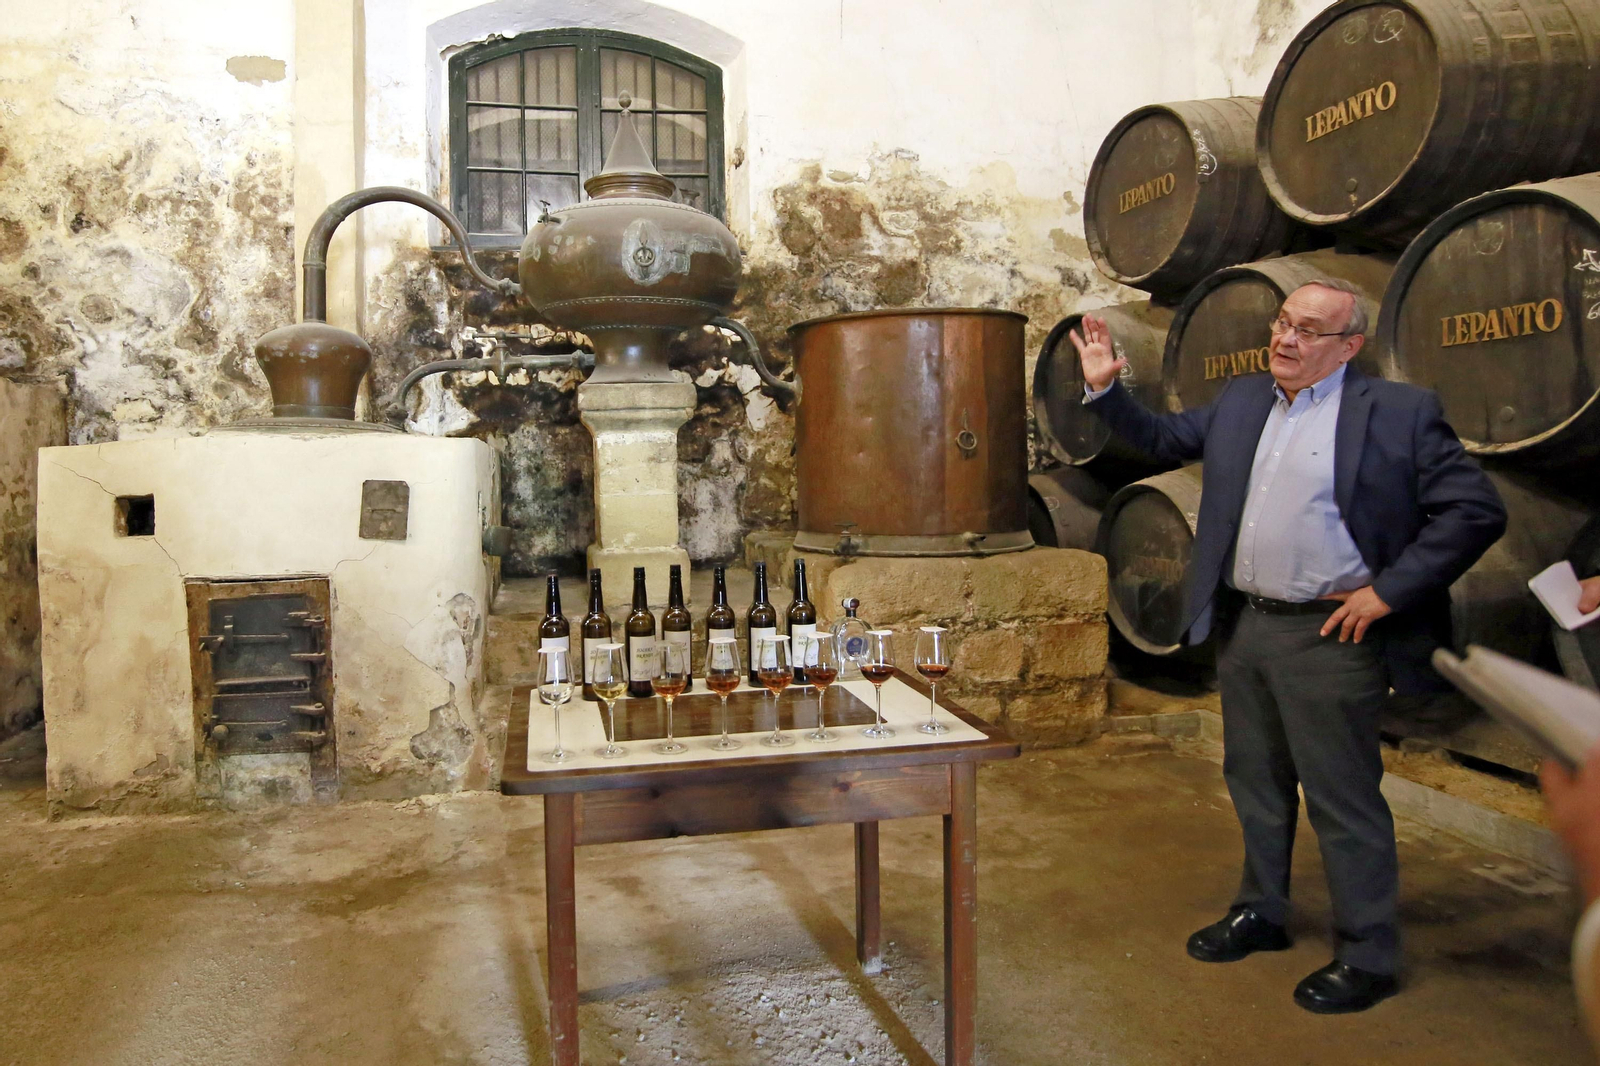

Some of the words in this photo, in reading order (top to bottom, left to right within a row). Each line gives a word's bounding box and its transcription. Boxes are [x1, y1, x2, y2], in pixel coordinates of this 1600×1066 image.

[1305, 80, 1397, 142] LEPANTO
[1119, 172, 1175, 214] LEPANTO
[1440, 298, 1563, 347] LEPANTO
[1204, 346, 1271, 380] LEPANTO
